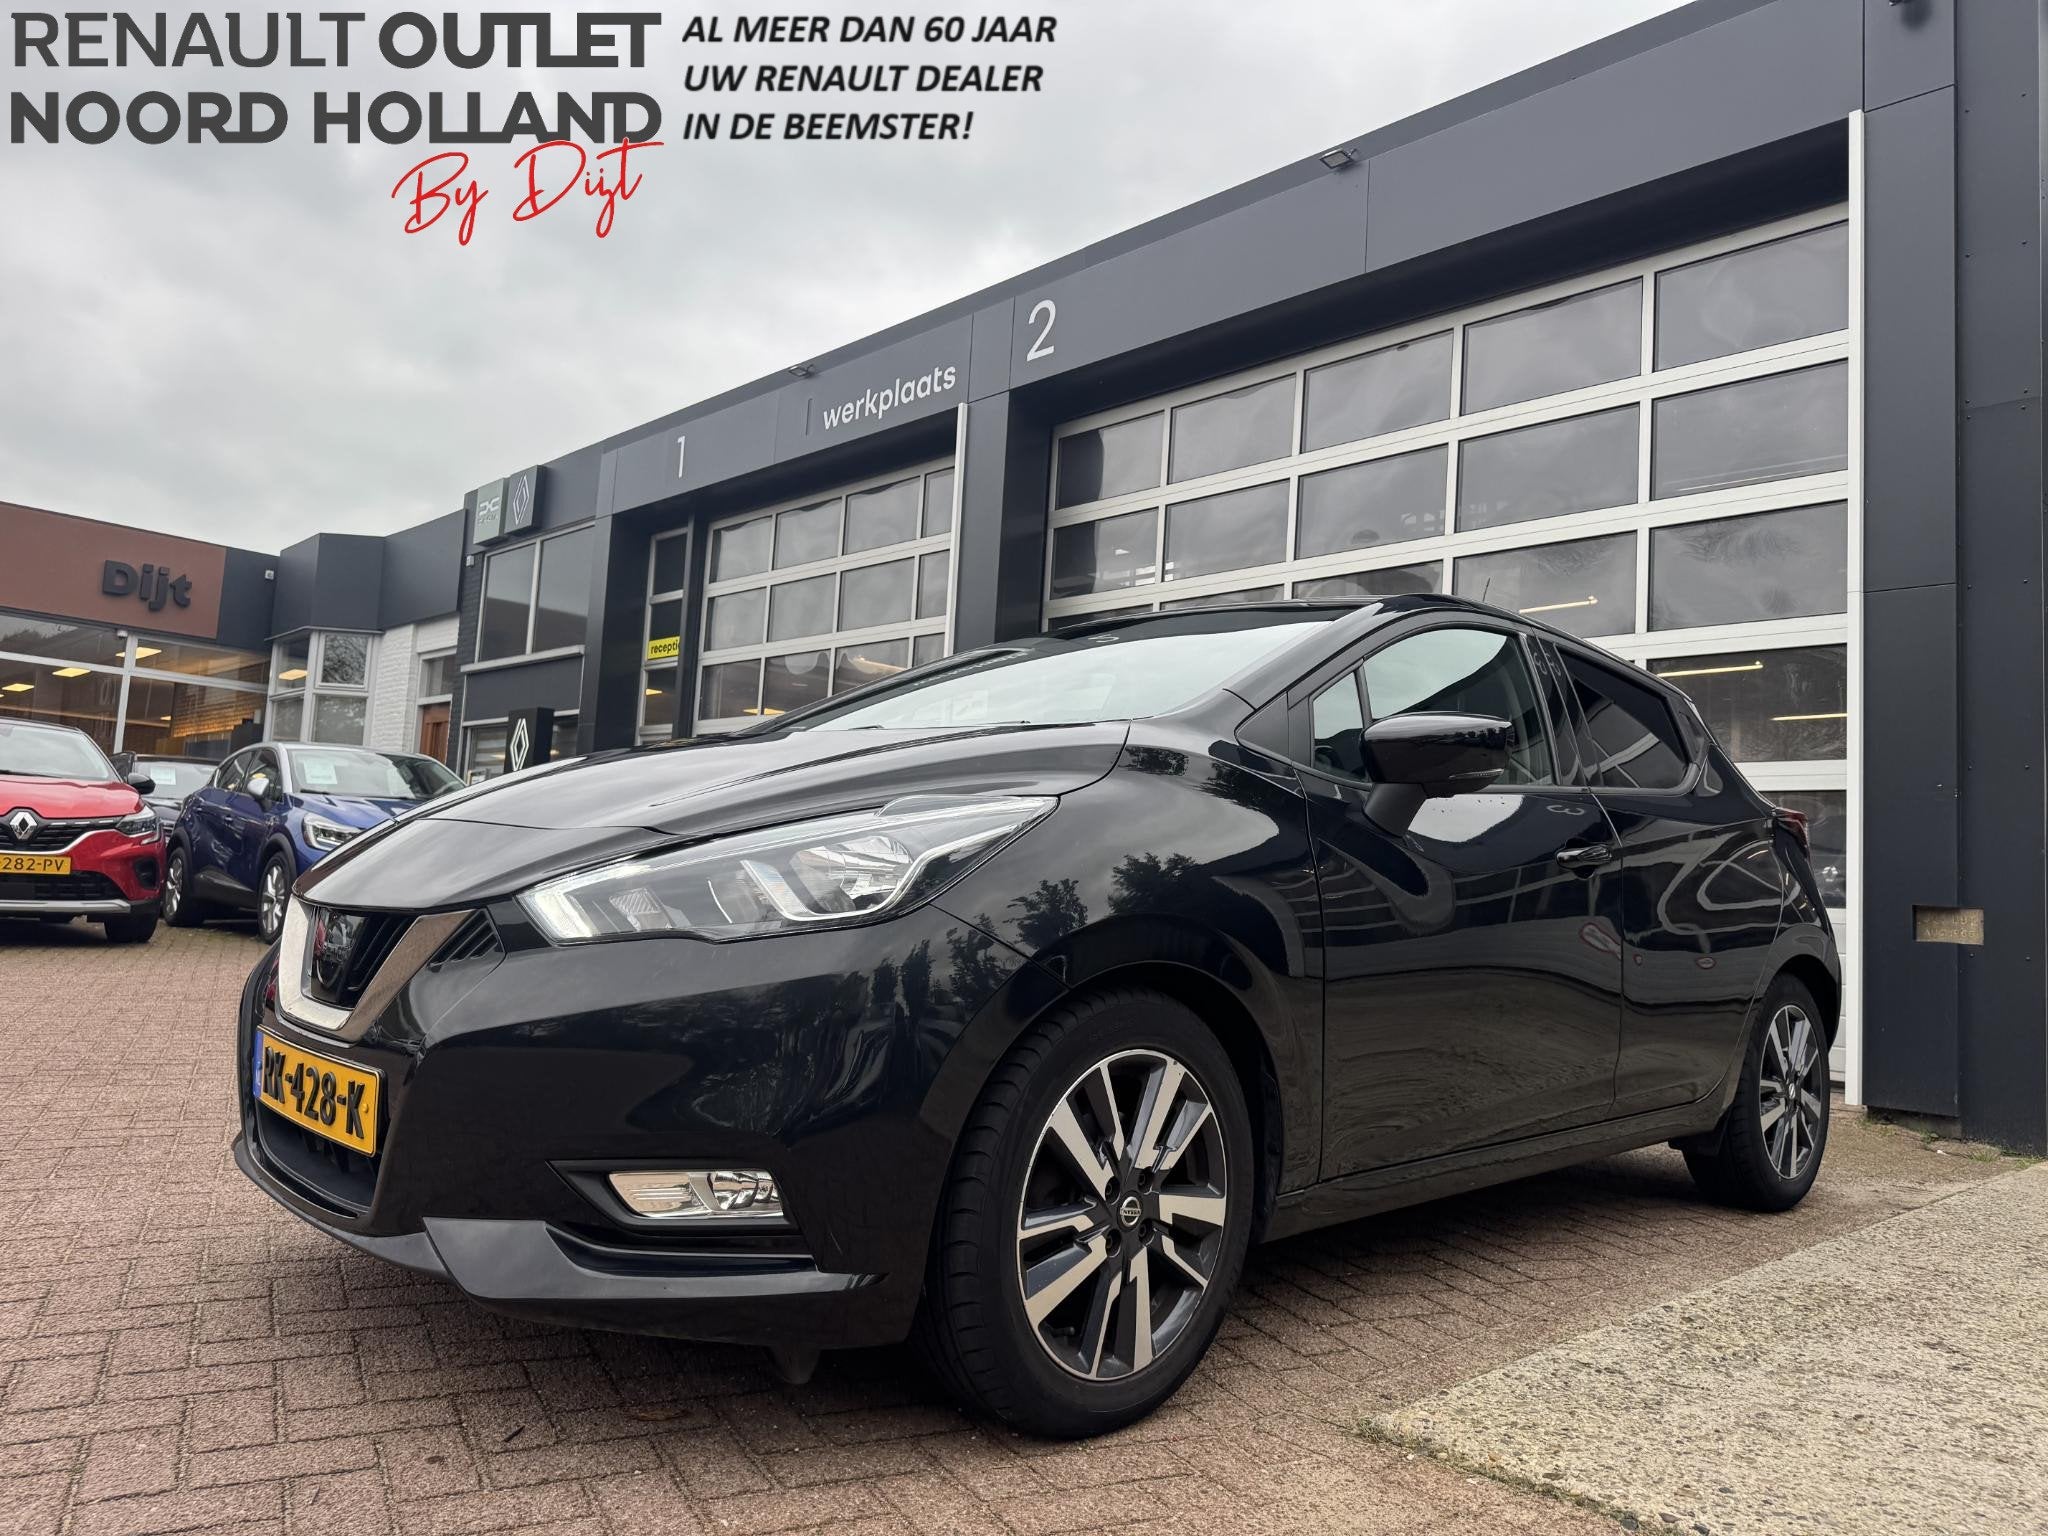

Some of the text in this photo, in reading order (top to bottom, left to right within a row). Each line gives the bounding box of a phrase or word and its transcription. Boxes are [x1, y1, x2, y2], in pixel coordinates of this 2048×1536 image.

[1027, 300, 1057, 362] 2
[823, 366, 956, 430] werkplaats
[677, 436, 686, 478] 1
[102, 560, 192, 612] Dijt
[263, 1046, 366, 1140] RK-428-K
